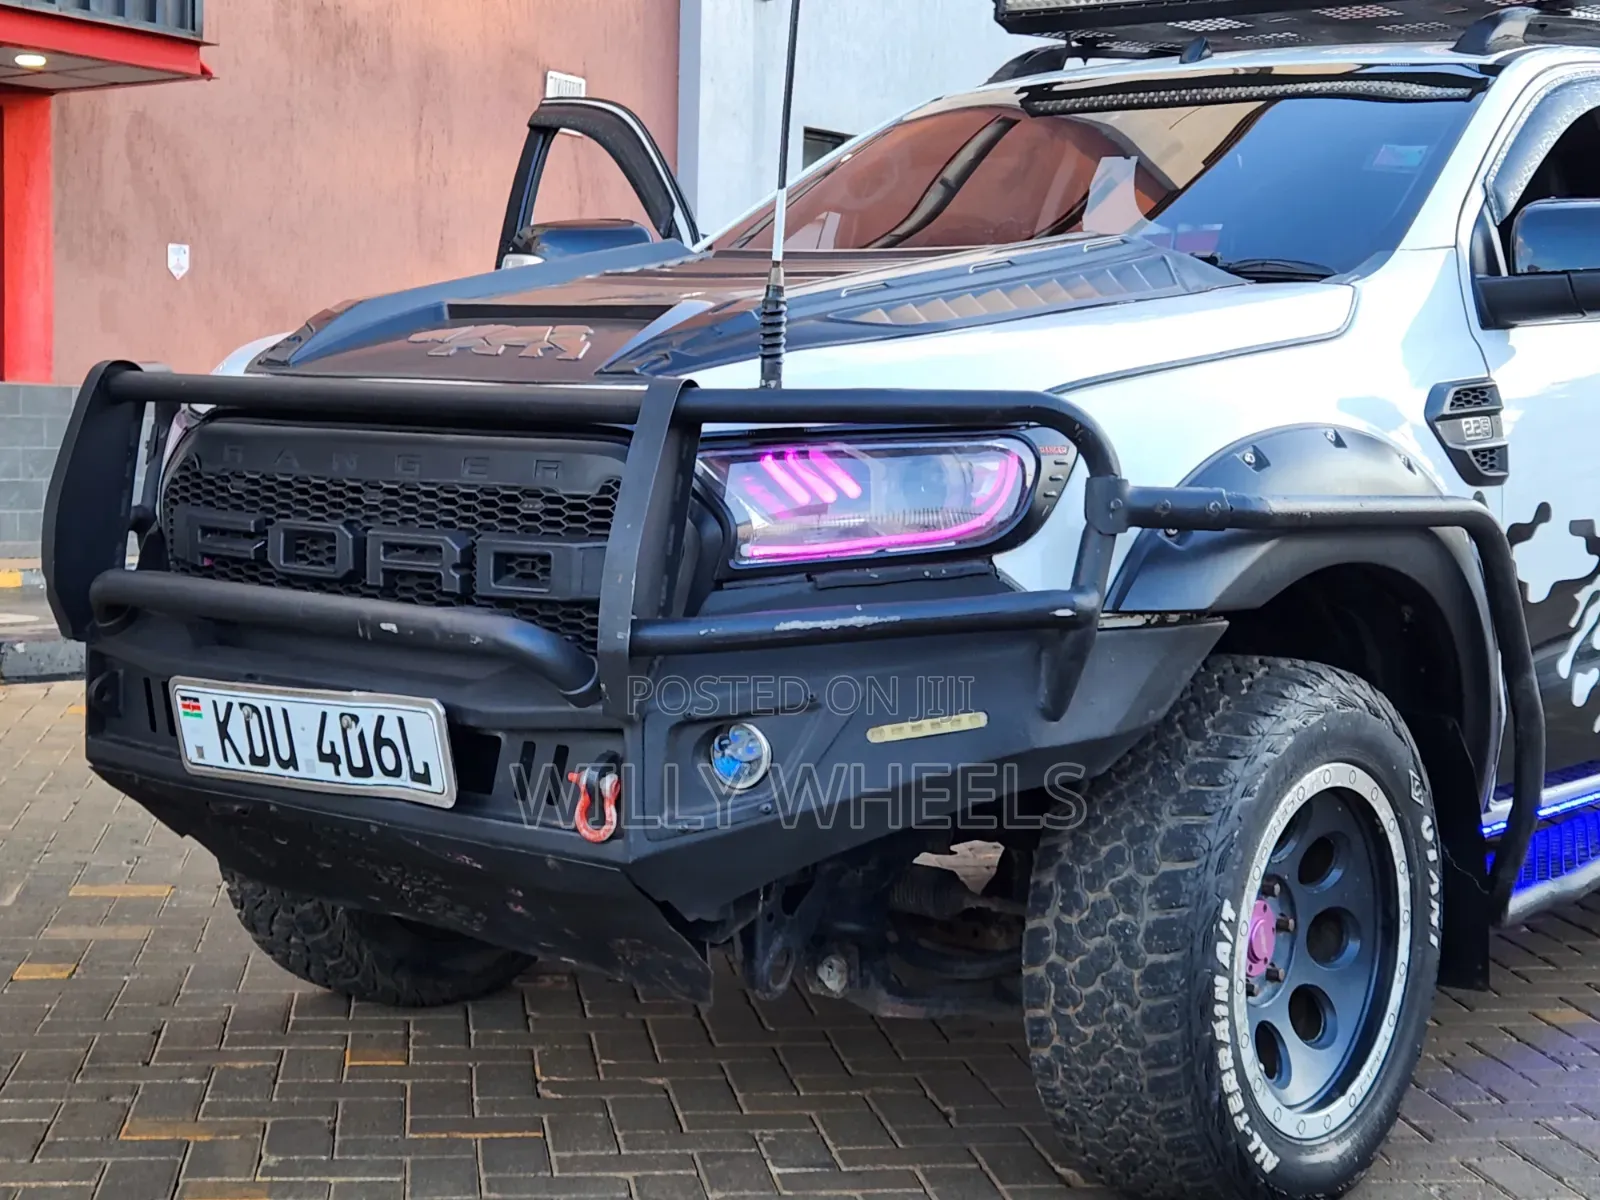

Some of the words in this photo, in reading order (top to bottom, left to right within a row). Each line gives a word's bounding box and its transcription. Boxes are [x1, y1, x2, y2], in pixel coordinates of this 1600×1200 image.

[222, 442, 564, 480] RANGER
[168, 506, 606, 600] FORD
[212, 699, 299, 771] KDU
[316, 711, 431, 785] 406L
[1215, 898, 1237, 971] A/T
[1211, 974, 1280, 1175] ALL-TERRAIN
